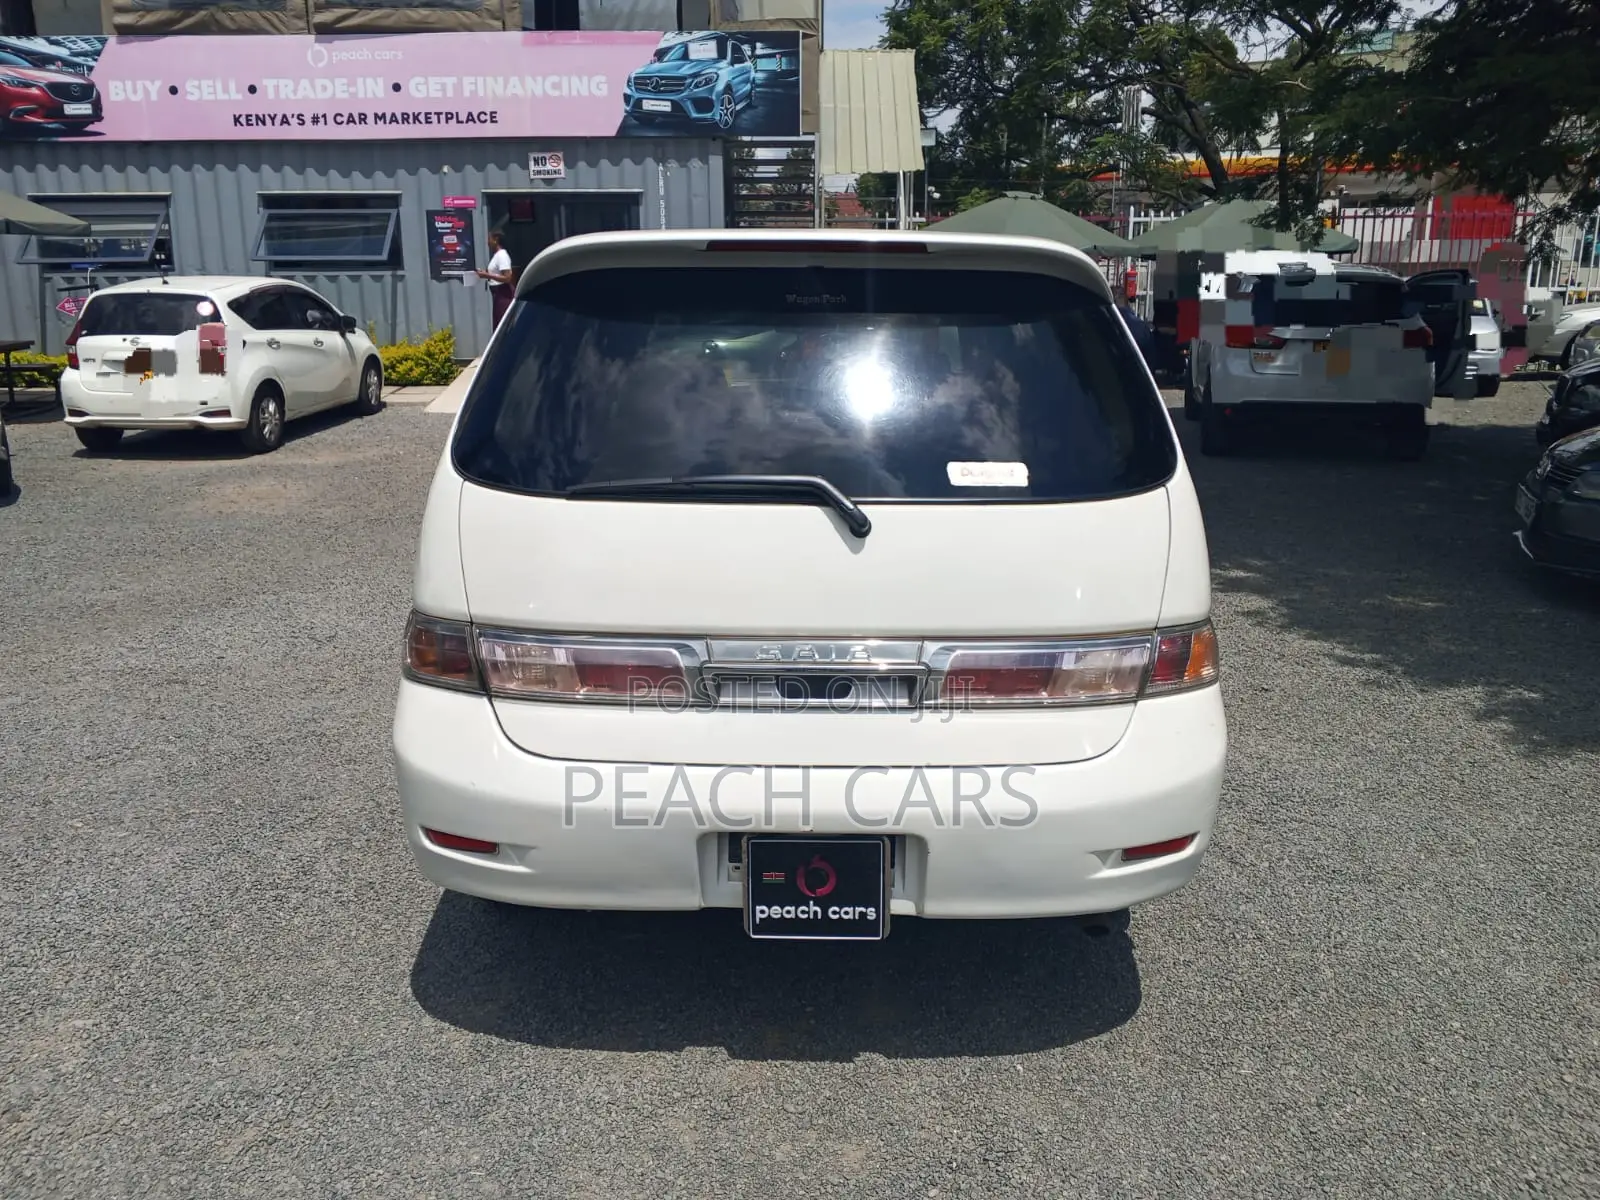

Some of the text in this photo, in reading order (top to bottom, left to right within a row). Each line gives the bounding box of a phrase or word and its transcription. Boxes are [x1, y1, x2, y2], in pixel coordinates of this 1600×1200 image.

[332, 46, 404, 63] peach cars
[109, 74, 609, 102] BUY SELL TRADE-IN GET FINANCING
[233, 110, 499, 127] KENYA'S #1 CAR MARKETPLACE
[533, 155, 547, 167] NO
[532, 169, 562, 177] SMOKING
[755, 901, 877, 924] peach cars
